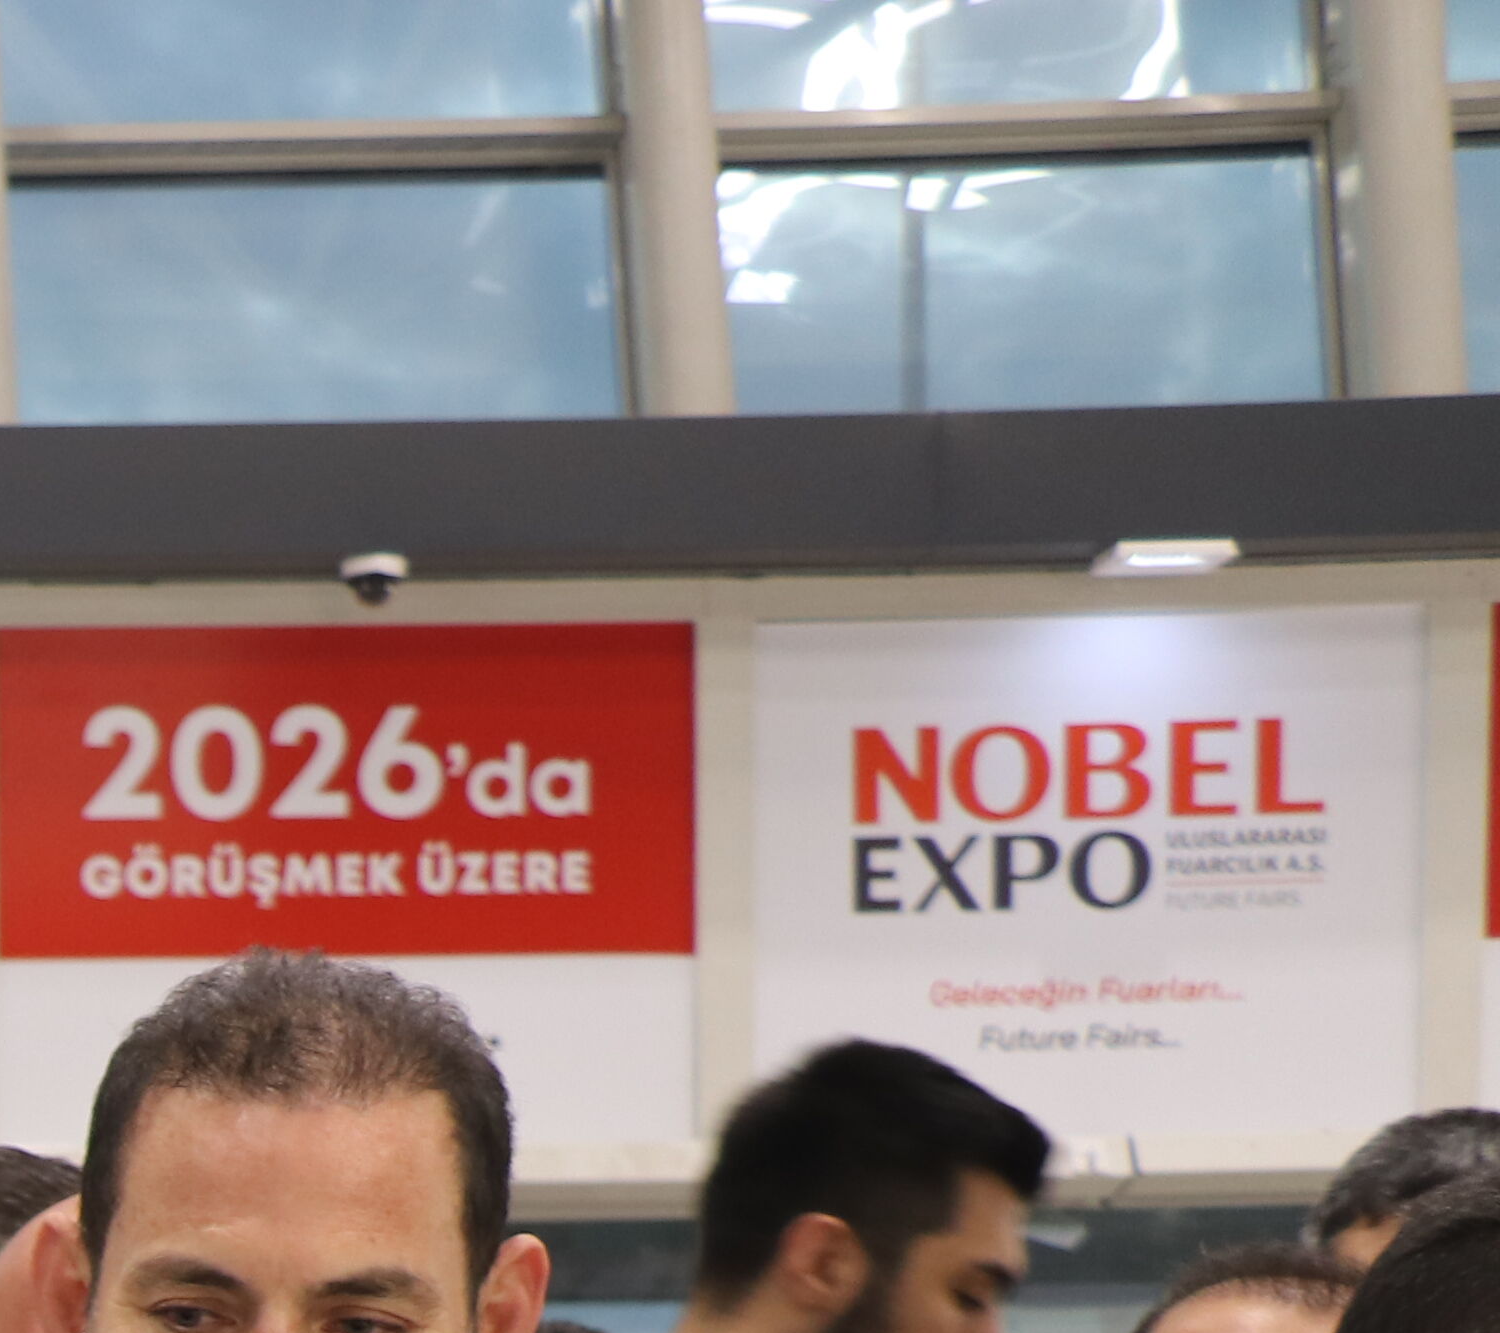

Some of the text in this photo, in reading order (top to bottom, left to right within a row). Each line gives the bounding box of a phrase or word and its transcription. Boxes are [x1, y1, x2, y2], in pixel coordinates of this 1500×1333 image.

[853, 718, 1326, 826] NOBEL
[79, 840, 594, 909] GÖRÜŞMEK ÜZERE
[852, 829, 1153, 914] EXPO
[978, 1025, 1079, 1051] Future
